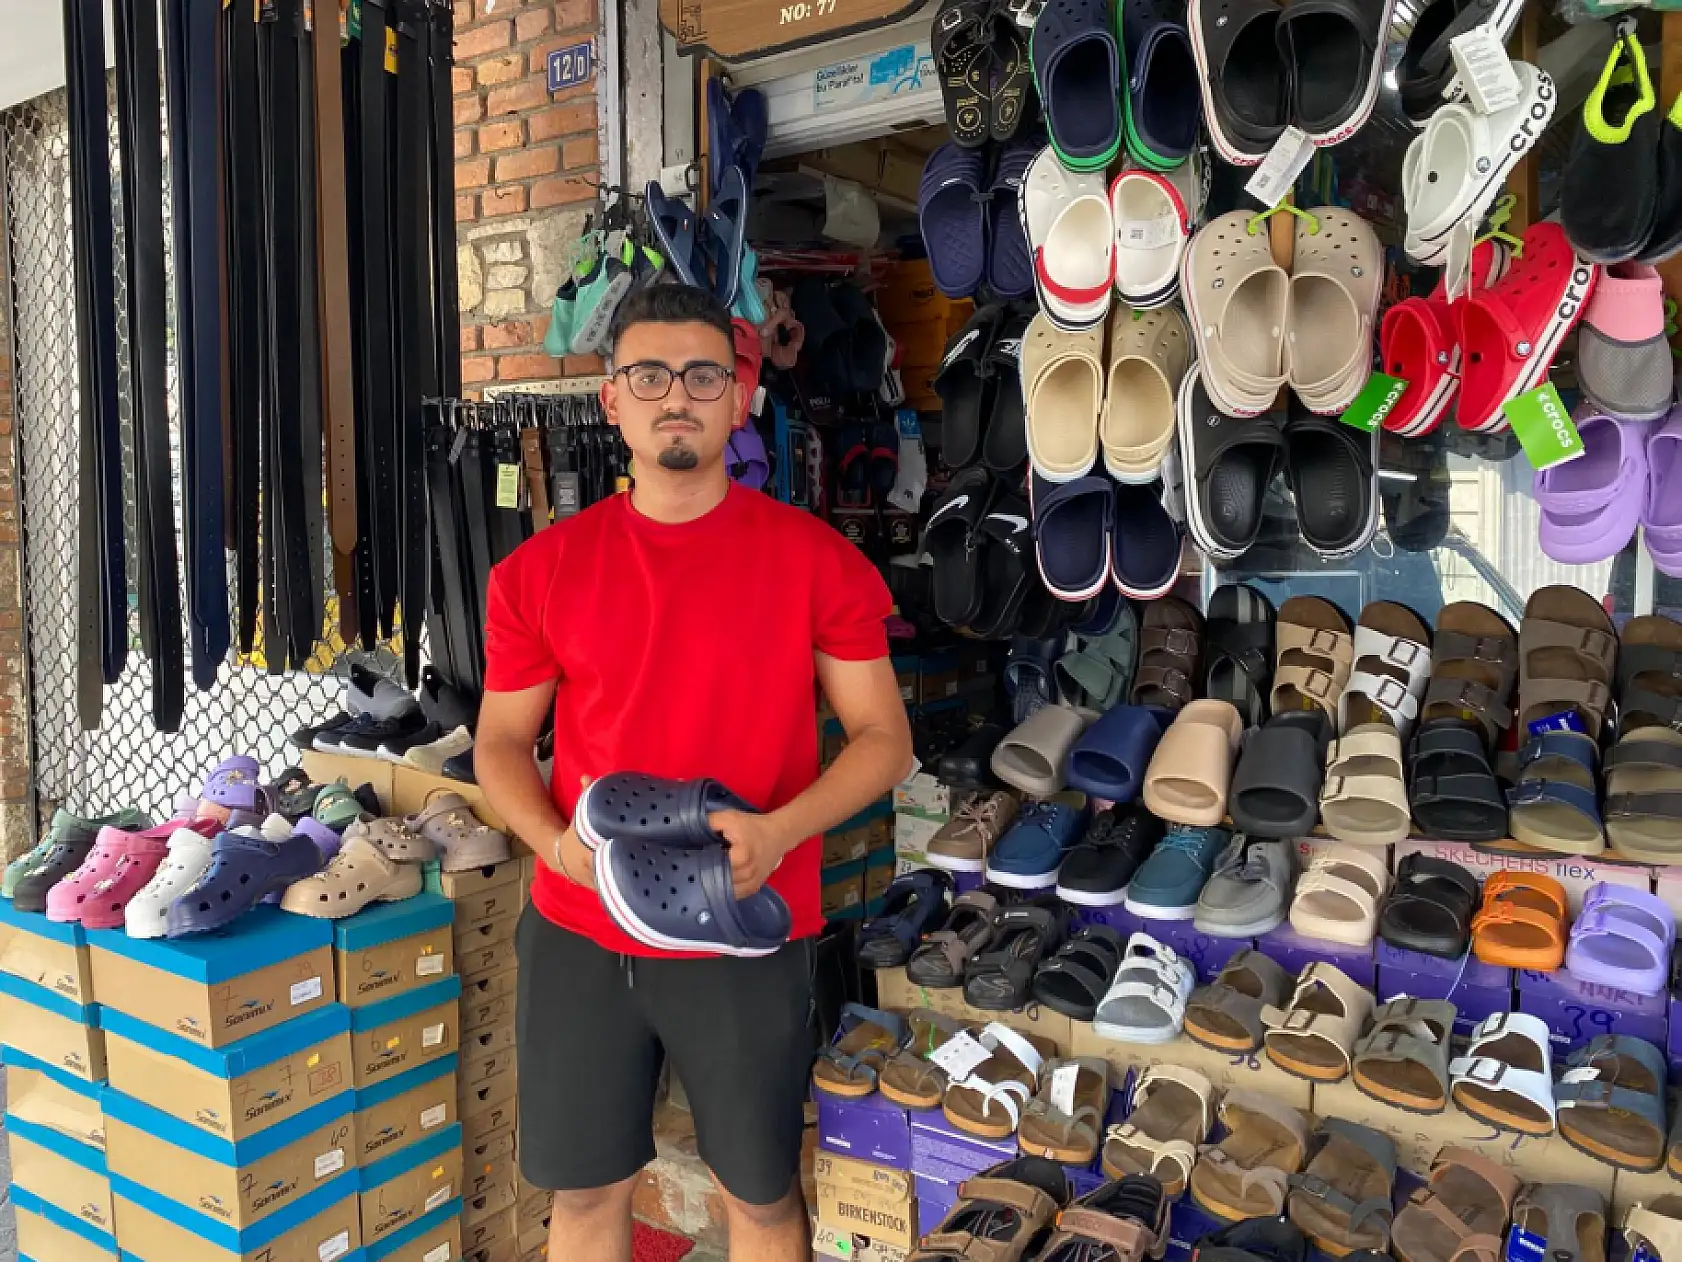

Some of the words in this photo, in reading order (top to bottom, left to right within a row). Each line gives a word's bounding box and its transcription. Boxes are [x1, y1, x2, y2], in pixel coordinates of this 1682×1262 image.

[780, 3, 812, 25] NO:
[553, 54, 572, 82] 12
[1510, 71, 1553, 152] crocs
[1558, 267, 1590, 320] cro
[1366, 391, 1400, 428] crocs
[1543, 402, 1574, 448] crocs
[1434, 845, 1549, 874] SKECHERS
[837, 1200, 907, 1234] BIRKENSTOCK
